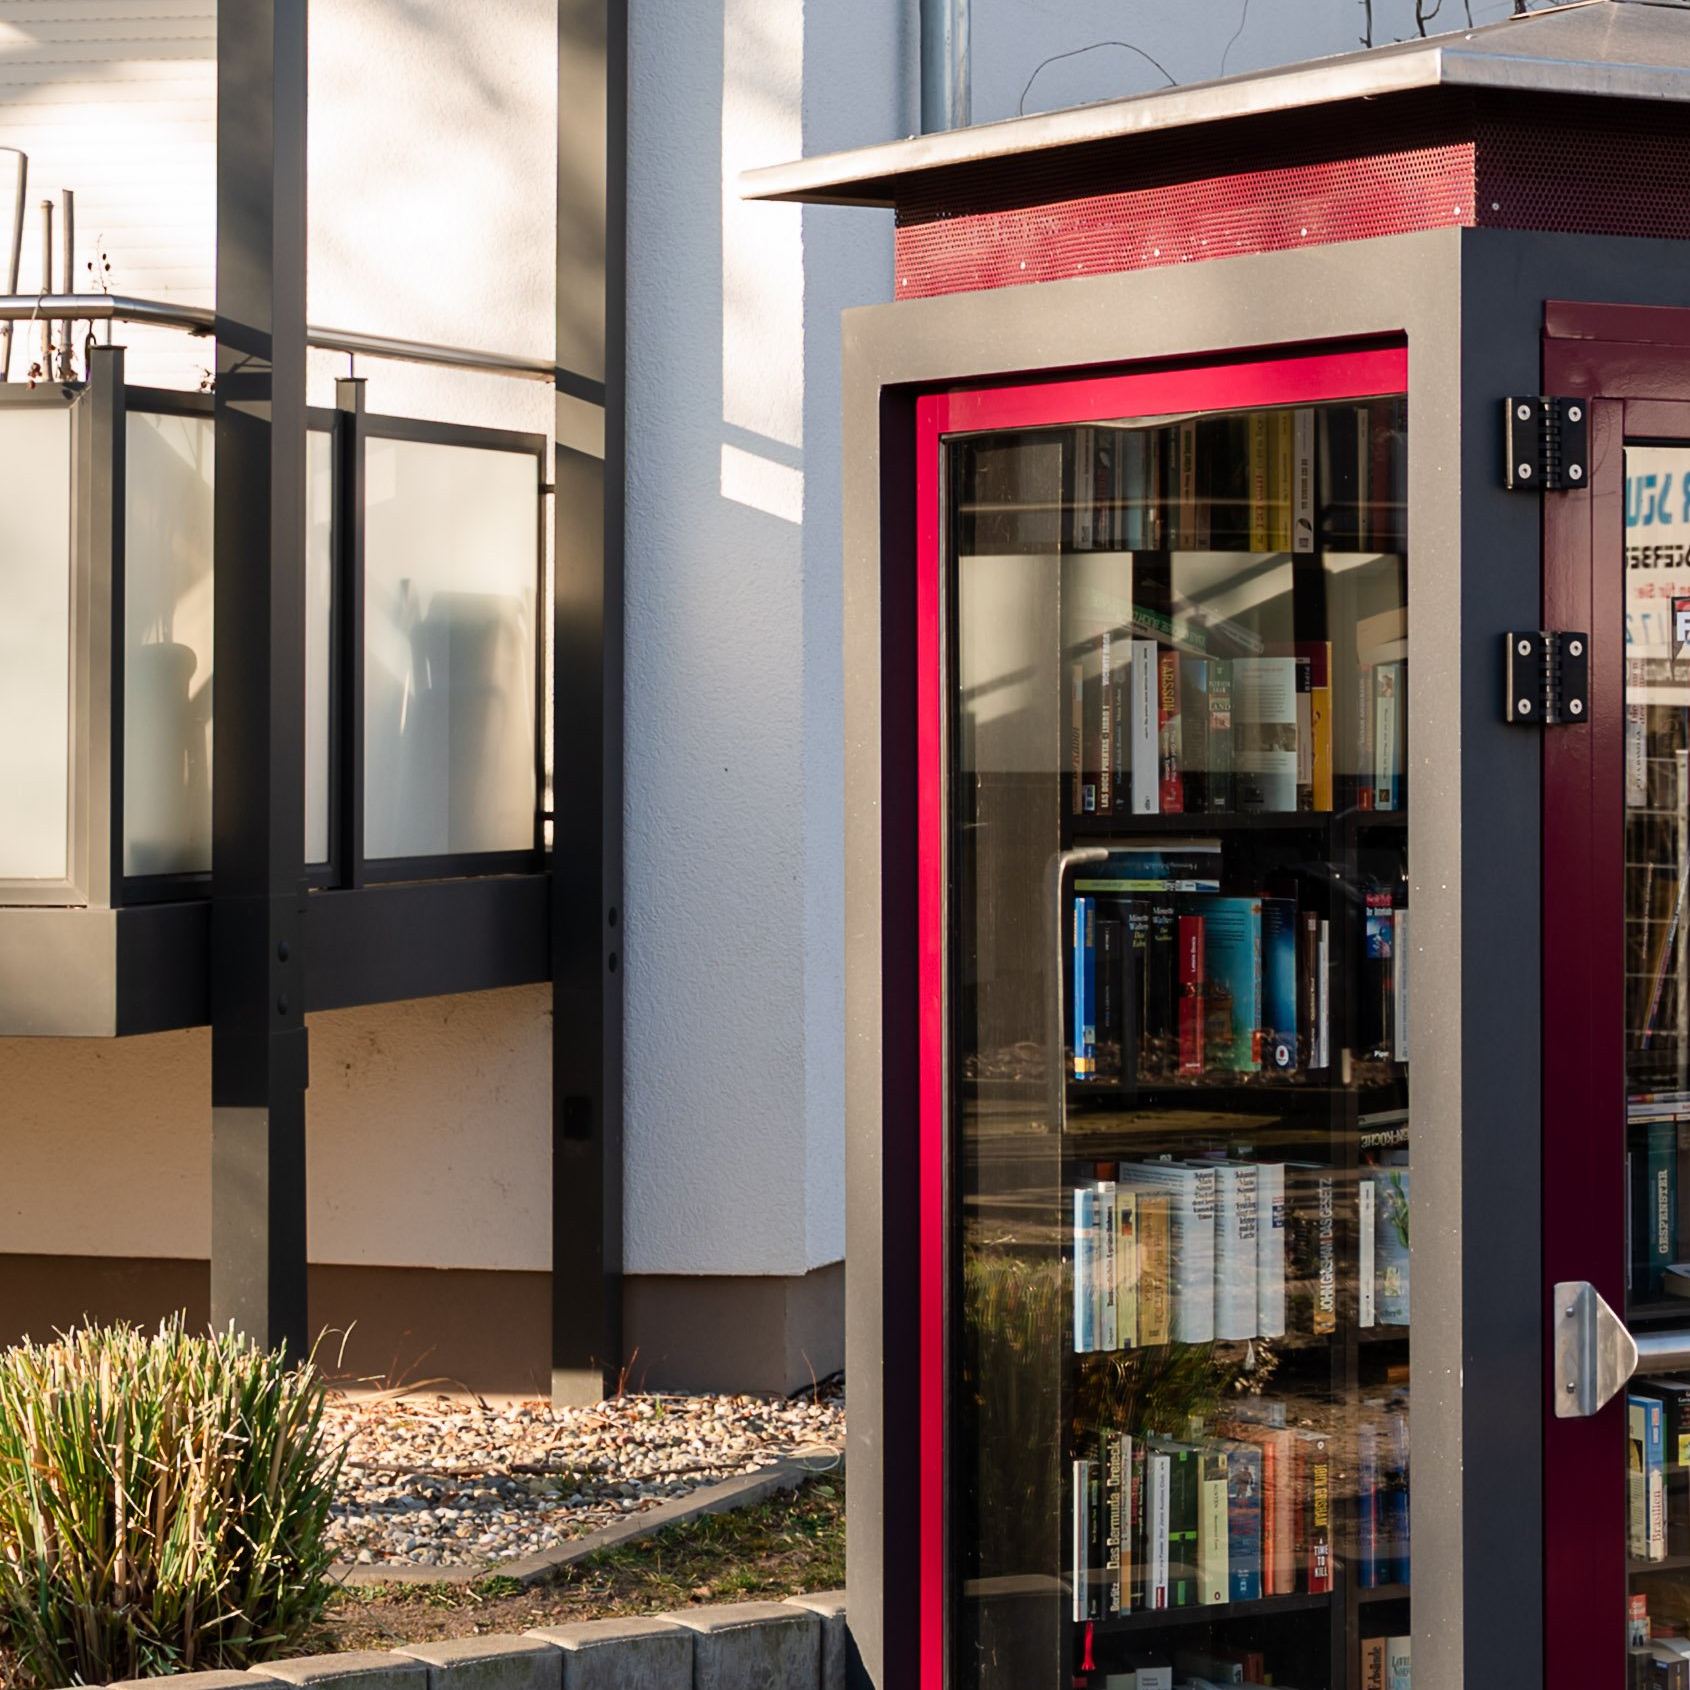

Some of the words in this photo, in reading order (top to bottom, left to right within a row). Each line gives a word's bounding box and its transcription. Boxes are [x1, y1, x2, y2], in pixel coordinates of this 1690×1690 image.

[1101, 738, 1110, 771] PUERTAS
[1101, 793, 1110, 807] LAS
[1318, 1177, 1332, 1217] GESETZ
[1658, 1169, 1669, 1254] GESPENSTER
[1319, 1218, 1332, 1237] DAS
[1319, 1240, 1333, 1283] GRISHAM
[1319, 1285, 1333, 1312] JOHN
[1314, 1464, 1327, 1487] JOHN
[1314, 1488, 1328, 1527] GRISHAM
[1652, 1491, 1661, 1541] Brasilien
[1107, 1547, 1120, 1569] Das
[1314, 1567, 1328, 1577] KILL
[1109, 1582, 1120, 1612] Berlitz
[1367, 1646, 1382, 1690] Erbsünde
